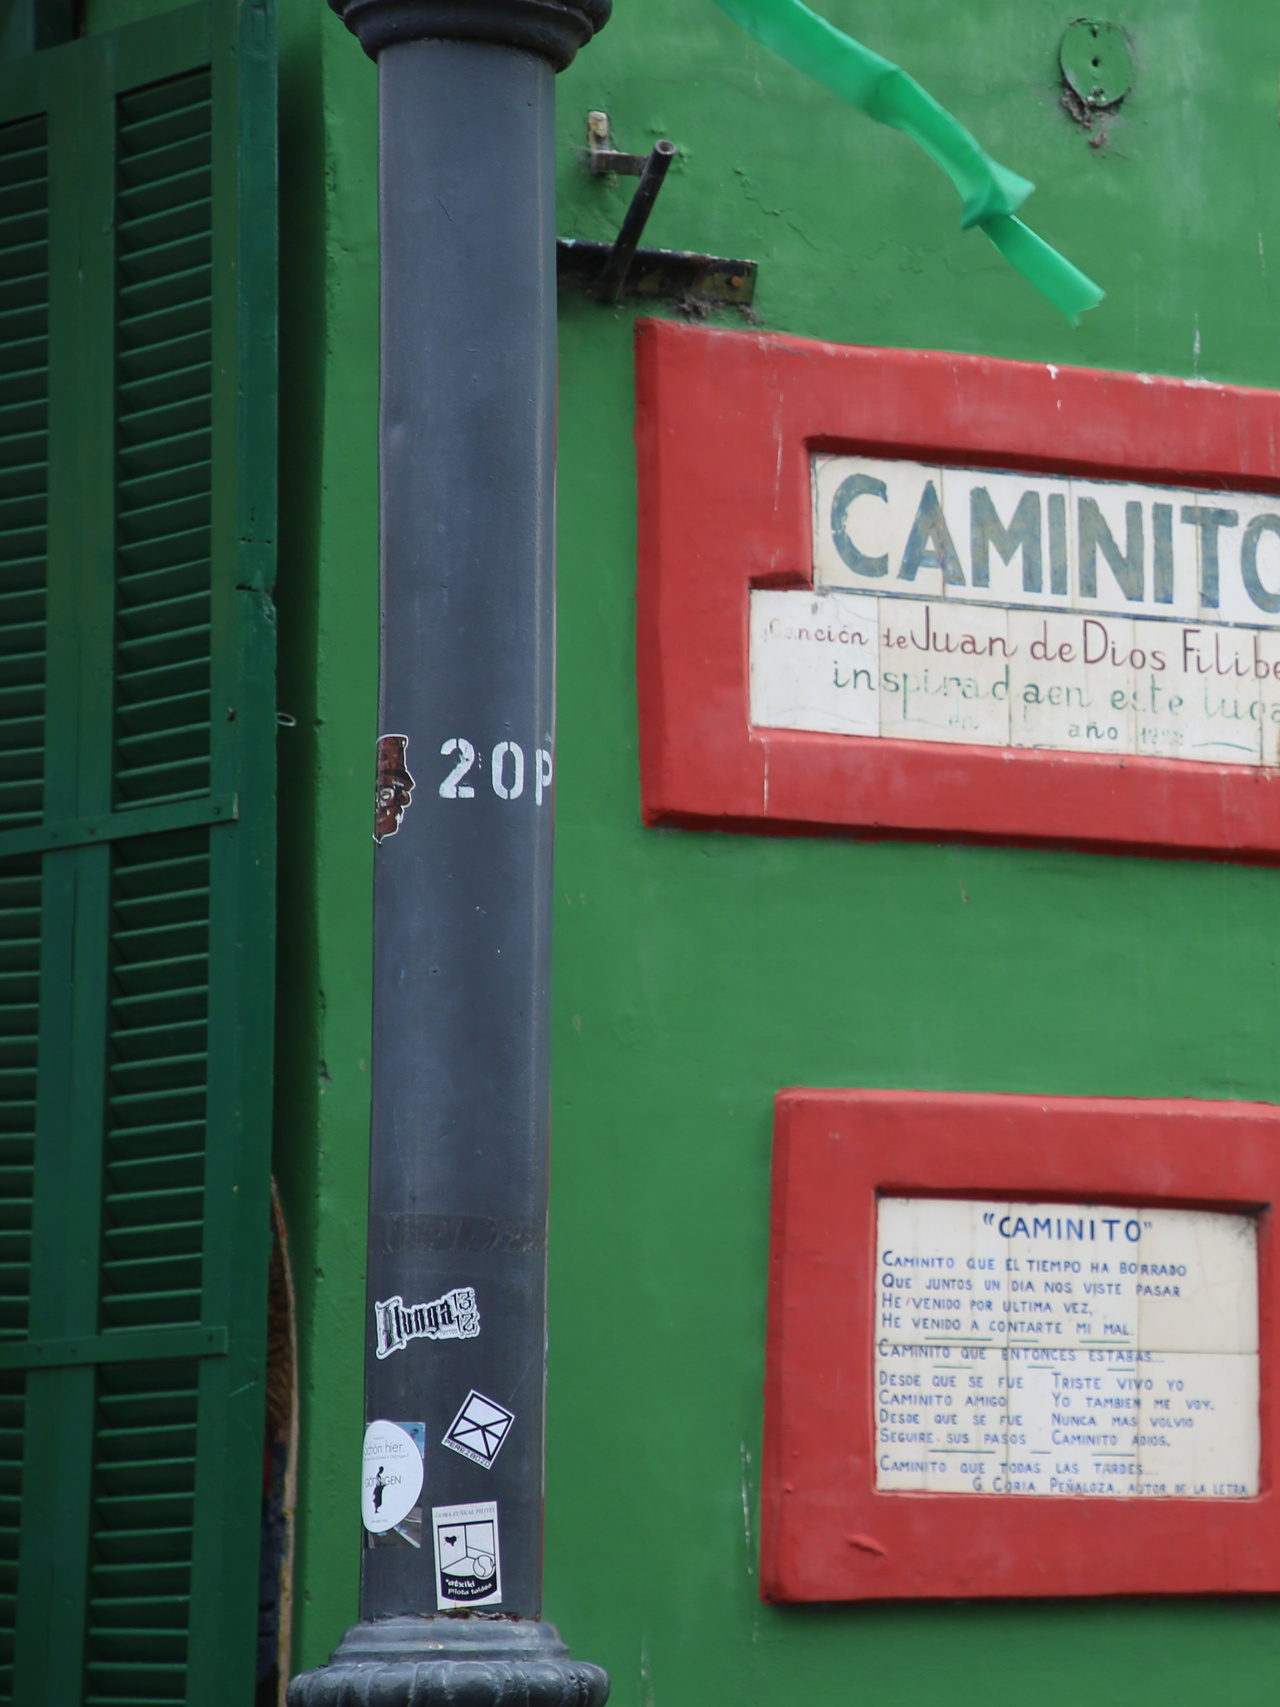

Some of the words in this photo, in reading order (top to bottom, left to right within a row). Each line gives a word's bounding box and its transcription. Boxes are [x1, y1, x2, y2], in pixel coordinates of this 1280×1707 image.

[910, 605, 1018, 658] Juan
[1030, 620, 1076, 663] de
[1083, 619, 1166, 671] Dios
[966, 1258, 996, 1271] QUE
[1005, 1258, 1020, 1271] EL
[1026, 1259, 1081, 1274] TIEMPO
[1090, 1262, 1110, 1274] HA
[1119, 1262, 1187, 1277] BORRADO
[925, 1278, 973, 1291] JUNTOS
[984, 1279, 1001, 1291] UN
[1011, 1280, 1036, 1293] DIA
[1044, 1282, 1073, 1294] NOS
[1083, 1283, 1122, 1296] VISTE
[1136, 1283, 1181, 1298] PASAR
[911, 1298, 961, 1310] VENIDO
[970, 1299, 993, 1312] POR
[1002, 1301, 1053, 1314] ULTIMA
[911, 1318, 961, 1331] VENIDO
[970, 1319, 980, 1332] A
[988, 1320, 1063, 1334] CONTARTE
[1076, 1323, 1092, 1335] MI
[960, 1347, 987, 1361] QUE
[1001, 1347, 1077, 1362] ENTONCES
[931, 1375, 957, 1388] QUE
[968, 1376, 984, 1389] SE
[998, 1376, 1024, 1390] FUE
[1115, 1378, 1154, 1391] VIVO
[1166, 1379, 1185, 1392] YO
[964, 1395, 1007, 1408] AMIGO
[1085, 1397, 1141, 1410] TAMBIEN
[1153, 1399, 1171, 1410] ME
[934, 1413, 958, 1426] QUE
[972, 1414, 987, 1426] SE
[999, 1415, 1023, 1427] FUE
[1111, 1416, 1138, 1427] MAS
[946, 1432, 970, 1444] SUS
[983, 1433, 1027, 1445] PASOS
[960, 1462, 986, 1474] QUE
[999, 1462, 1041, 1475] TODAS
[1055, 1462, 1080, 1475] LAS
[1127, 1482, 1167, 1494] AUTOR
[1173, 1483, 1187, 1494] DE
[1192, 1483, 1206, 1495] LA
[1212, 1483, 1248, 1495] LETRA
